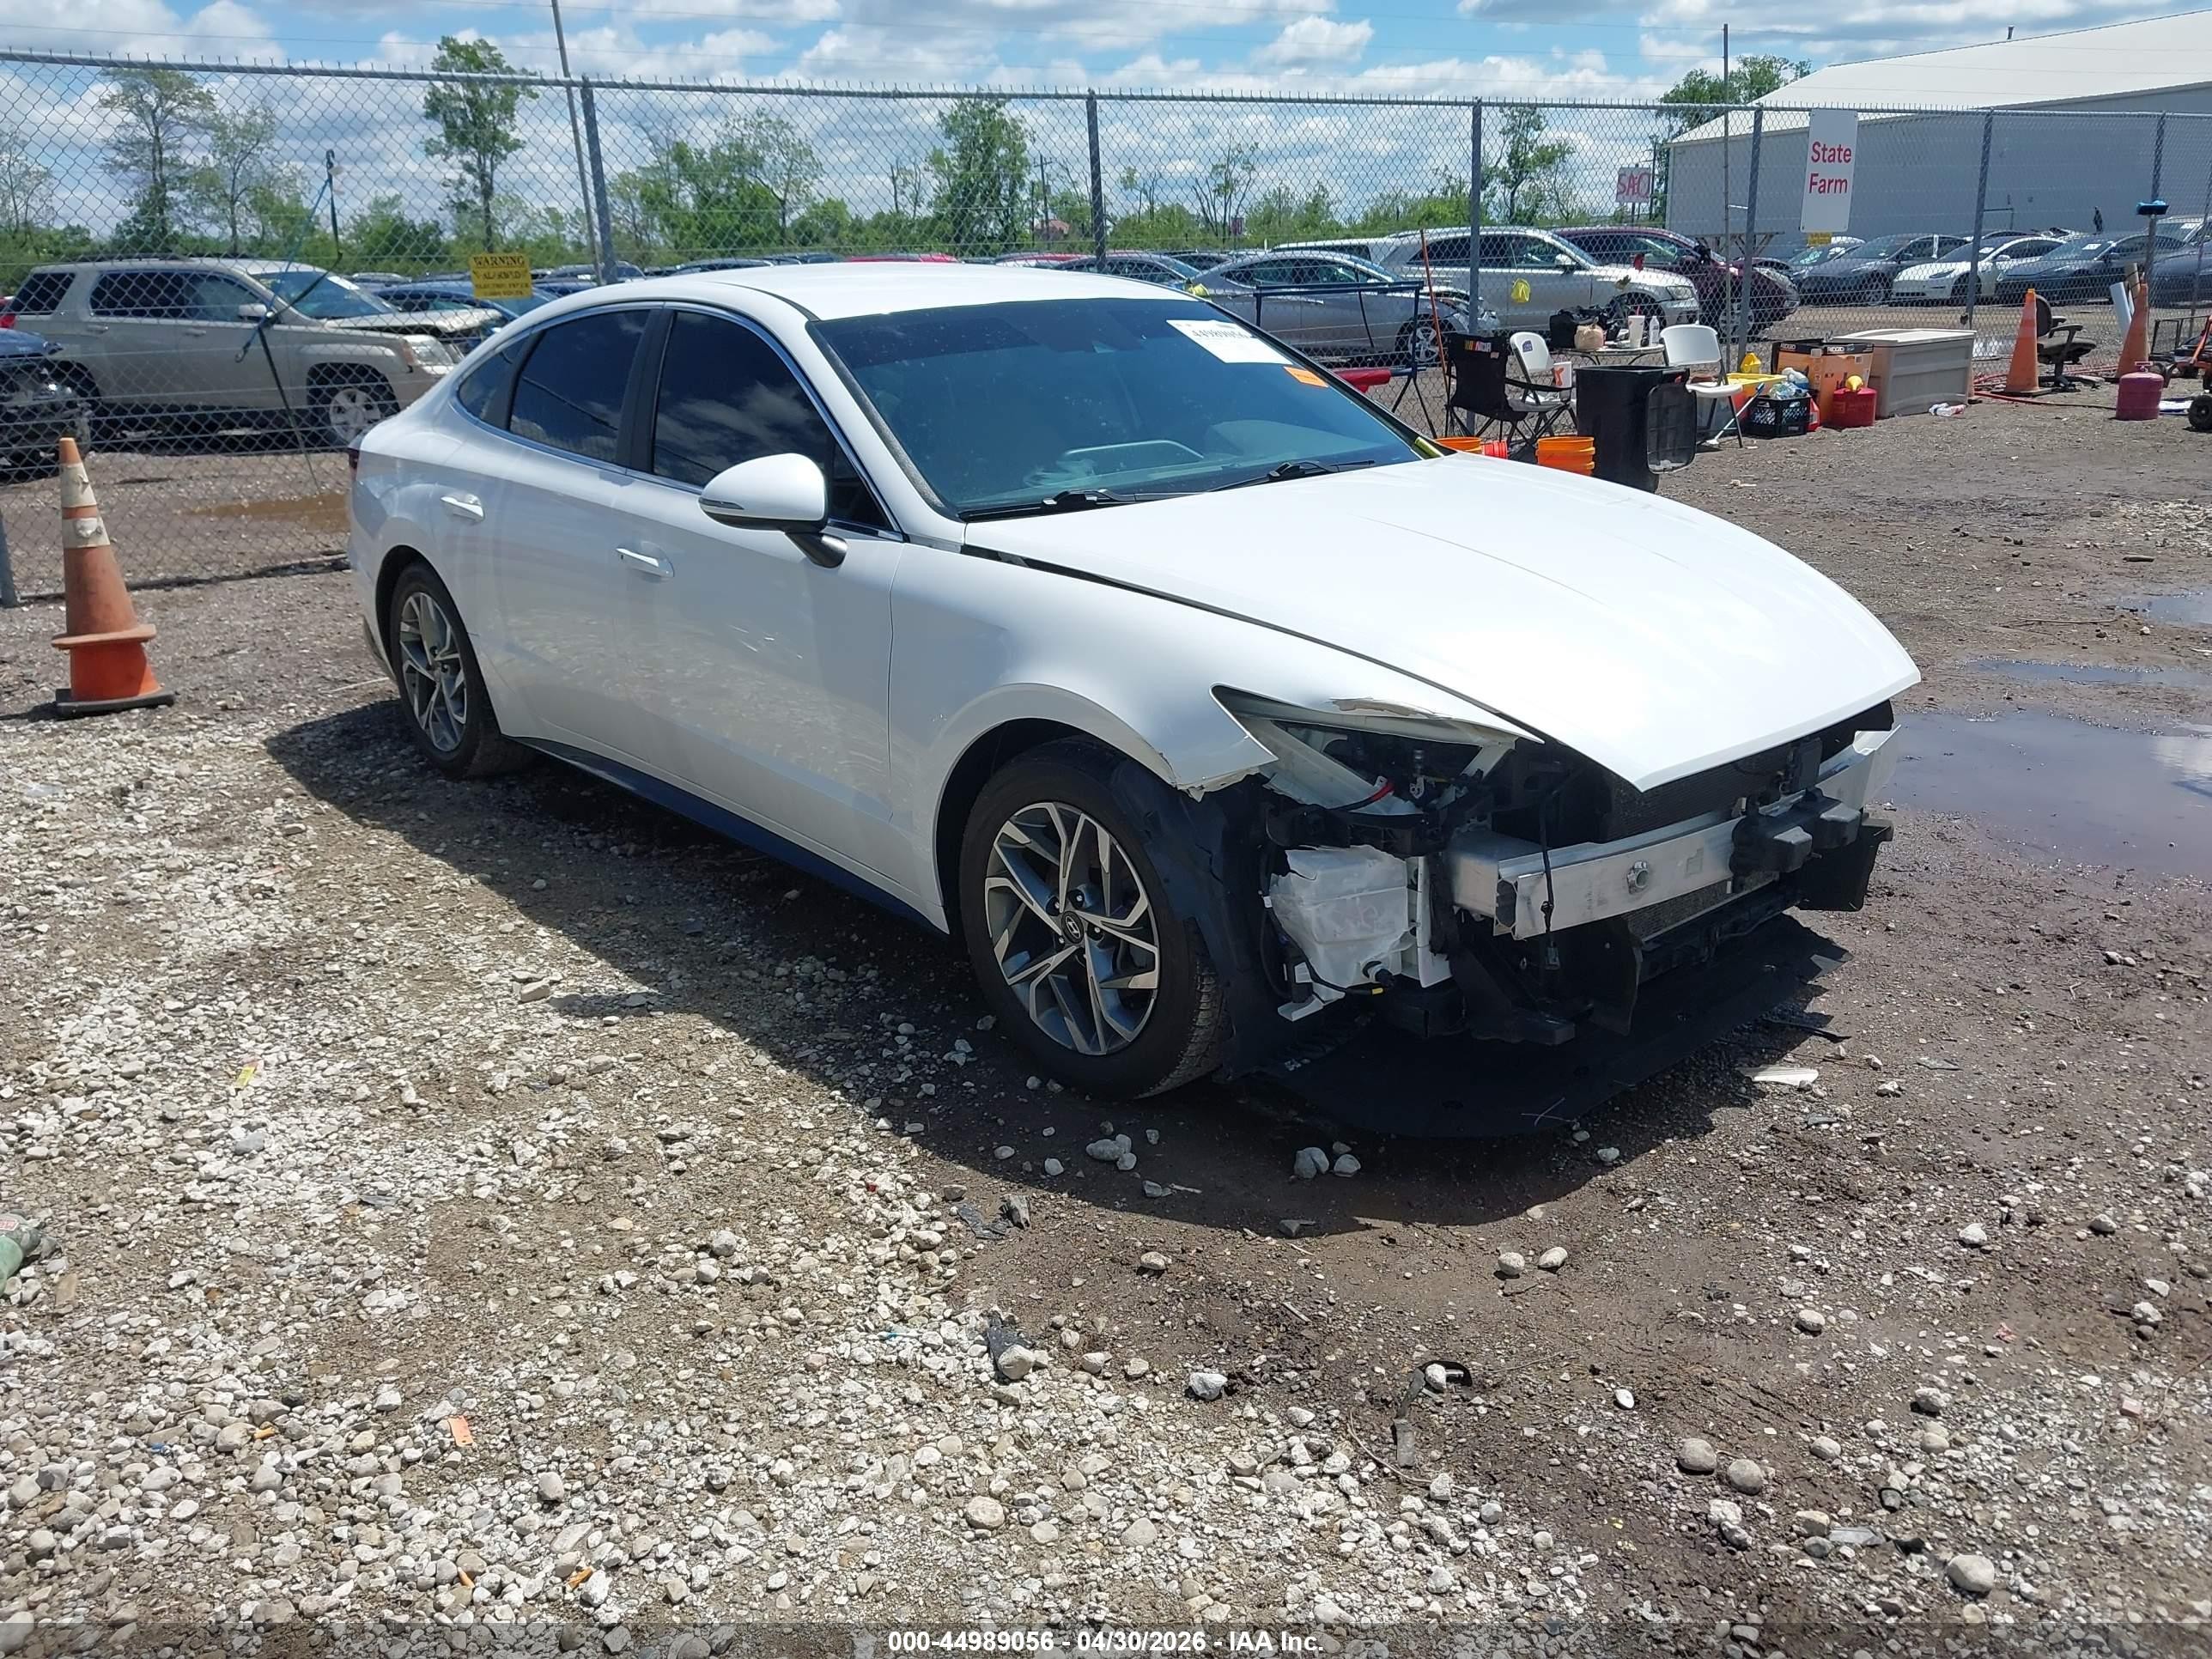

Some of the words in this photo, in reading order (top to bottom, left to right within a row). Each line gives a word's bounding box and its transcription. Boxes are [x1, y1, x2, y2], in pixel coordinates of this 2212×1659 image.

[1811, 141, 1852, 163] State
[1808, 173, 1848, 194] Farm
[473, 255, 525, 266] WARNING
